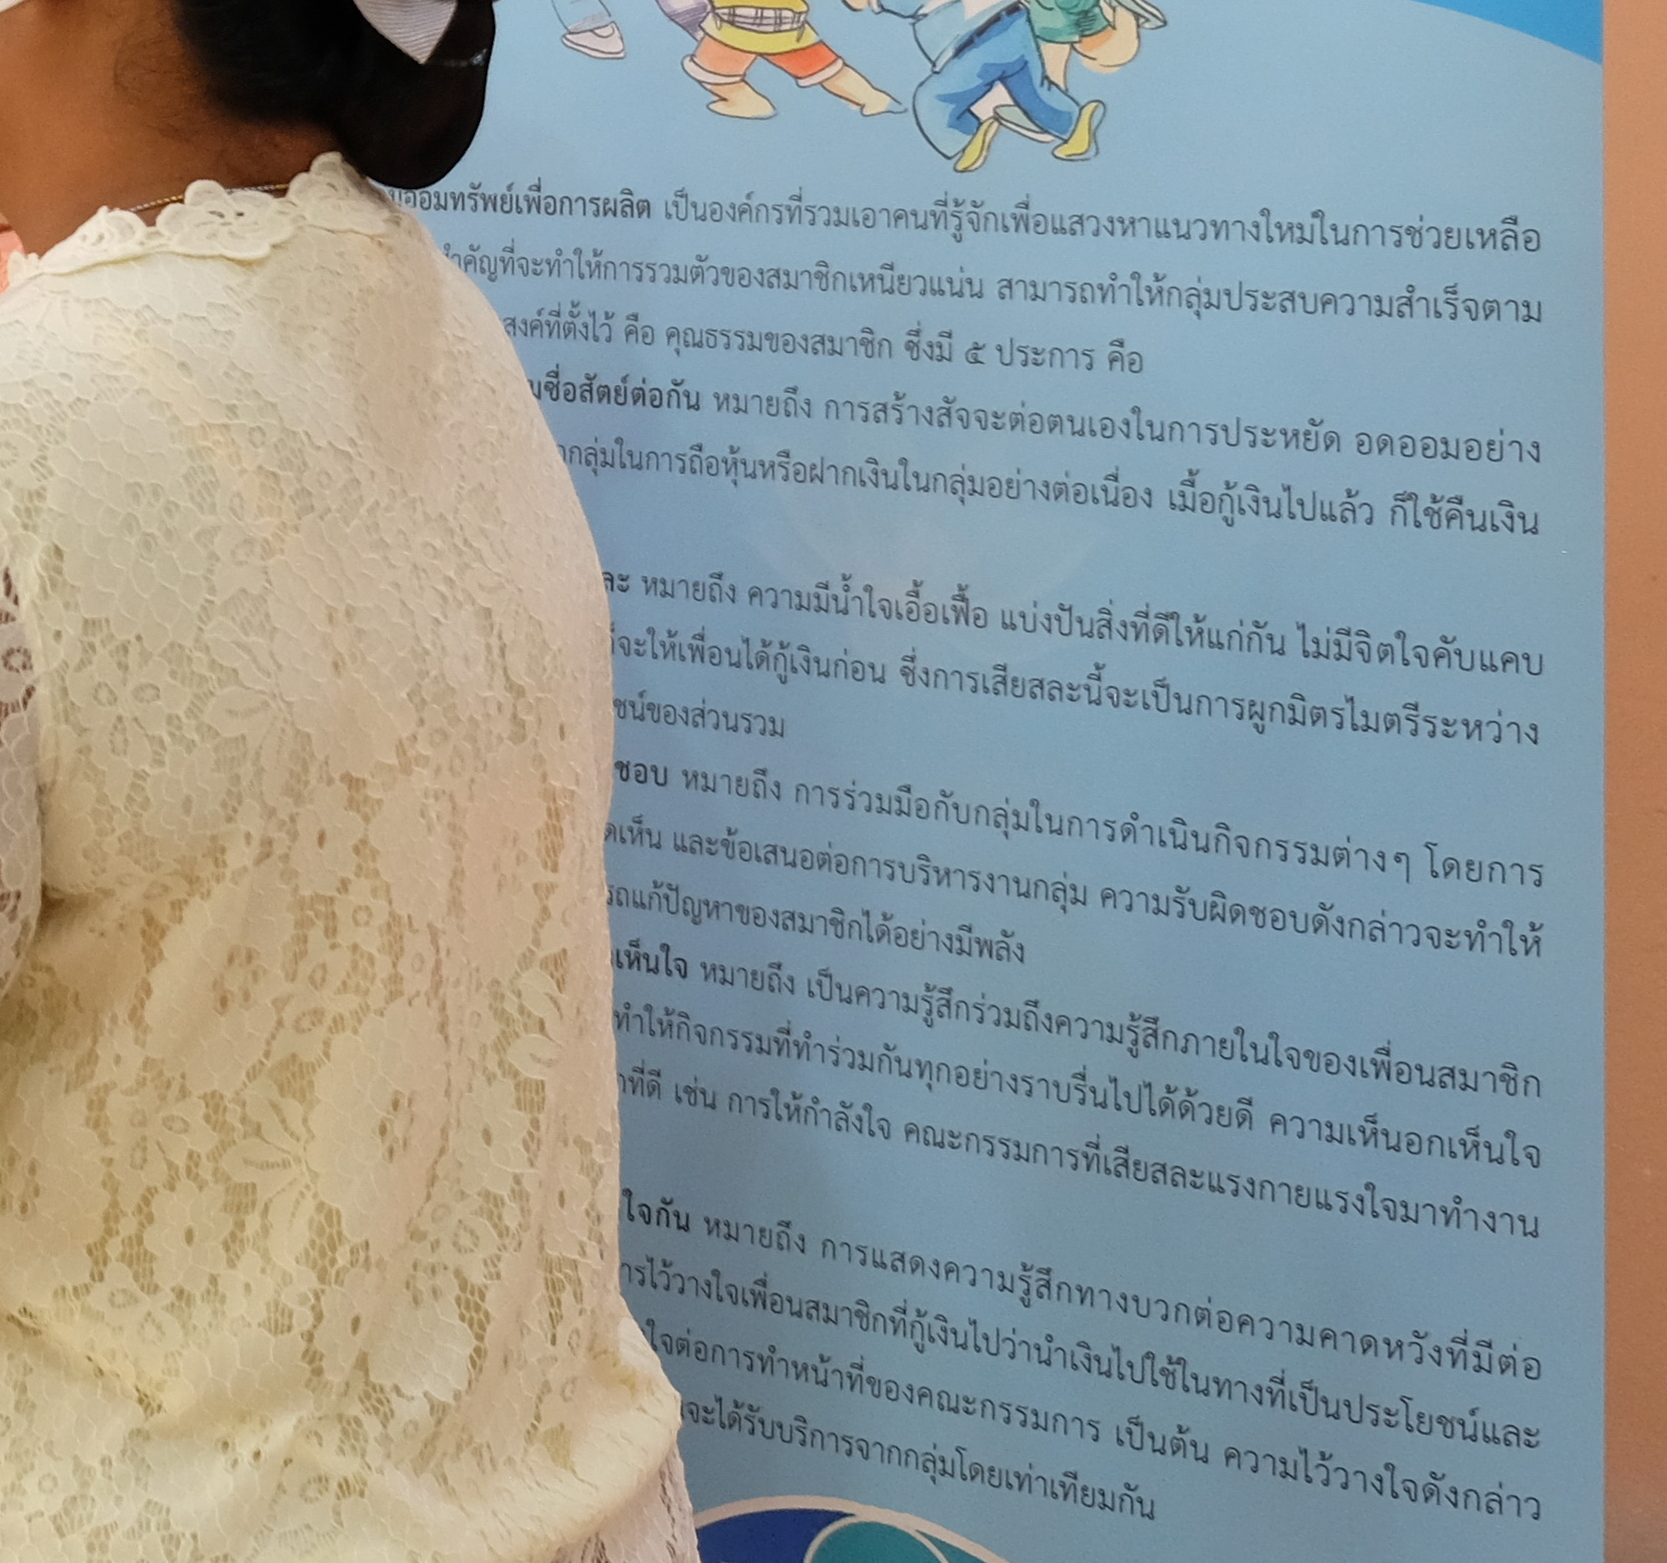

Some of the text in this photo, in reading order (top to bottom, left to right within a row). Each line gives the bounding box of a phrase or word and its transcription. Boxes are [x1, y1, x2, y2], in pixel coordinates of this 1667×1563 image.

[624, 312, 655, 347] คือ
[665, 325, 893, 359] คุณธรรมของสมาชิก
[904, 320, 954, 363] ซึ่งมี
[964, 341, 987, 365] ๕
[994, 337, 1096, 372] ประการ
[1107, 337, 1144, 374] คือ
[996, 270, 1543, 324] สามารถทำให้กลุ่มประสบความสำเร็จตาม
[712, 385, 812, 419] หมายถึง
[824, 390, 1341, 453] การสร้างสัจจะต่อตนเองในการประหยัด
[1354, 427, 1541, 464] อดออมอย่าง
[1389, 490, 1540, 536] ก็ใช้คืนเงิน
[641, 571, 737, 605] หมายถึง
[747, 572, 989, 630] ความมีน้ำใจเอื้อเฟื้อ
[1000, 598, 1287, 657] แบ่งปันสิ่งที่ดีให้แก่กัน
[1295, 621, 1544, 677] ไม่มีจิตใจคับแคบ
[899, 646, 1540, 746] ซึ่งการเสียสละนี้จะเป็นการผูกมิตรไมตรีระหว่าง
[613, 760, 1544, 888] ชอบ หมายถึง การร่วมมือกับกลุ่มในการดำเนินกิจกรรมต่างๆ โดยการ
[673, 826, 1088, 915] และข้อเสนอต่อการบริหารงานกลุ่ม
[1099, 884, 1545, 958] ความรับผิดชอบดังกล่าวจะทำให้
[699, 961, 796, 996] หมายถึง
[807, 966, 1542, 1098] เป็นความรู้สึกร่วมถึงความรู้สึกภายในใจของเพื่อนสมาชิก
[674, 1075, 717, 1111] เช่น
[728, 1086, 892, 1141] การให้กำลังใจ
[903, 1121, 1540, 1239] คณะกรรมการที่เสียสละแรงกายแรงใจมาทำงาน
[1269, 1112, 1541, 1169] ความเห็นอกเห็นใจ
[703, 1215, 806, 1255] หมายถึง
[821, 1238, 1542, 1381] การแสดงความรู้สึกทางบวกต่อความคาดหวังที่มีต่อ
[680, 1394, 1156, 1521] จะได้รับบริการจากกลุ่มโดยเท่าเทียมกัน
[1115, 1414, 1210, 1465] เป็นต้น
[1223, 1445, 1541, 1521] ความไว้วางใจดังกล่าว
